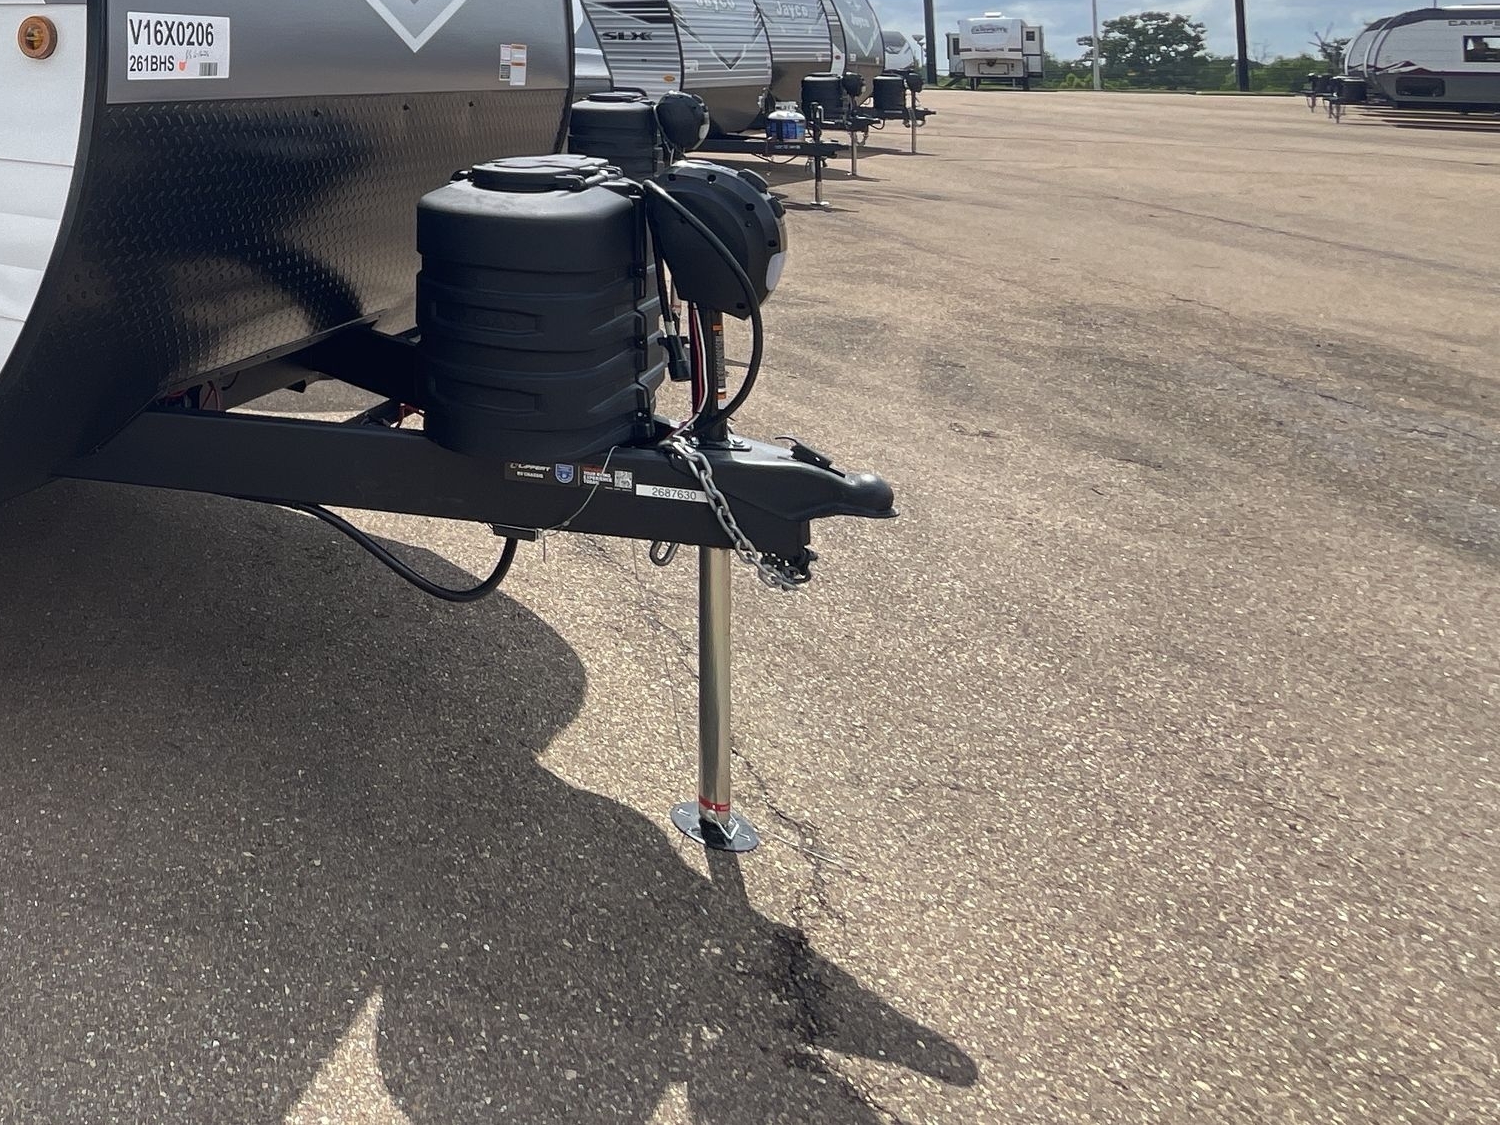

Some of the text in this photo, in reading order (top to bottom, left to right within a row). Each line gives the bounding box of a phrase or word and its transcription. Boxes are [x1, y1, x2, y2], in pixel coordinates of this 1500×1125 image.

[776, 0, 809, 21] Jayco
[129, 18, 214, 47] V16X0206
[129, 55, 175, 72] 261BHS
[652, 486, 697, 500] 2687630
